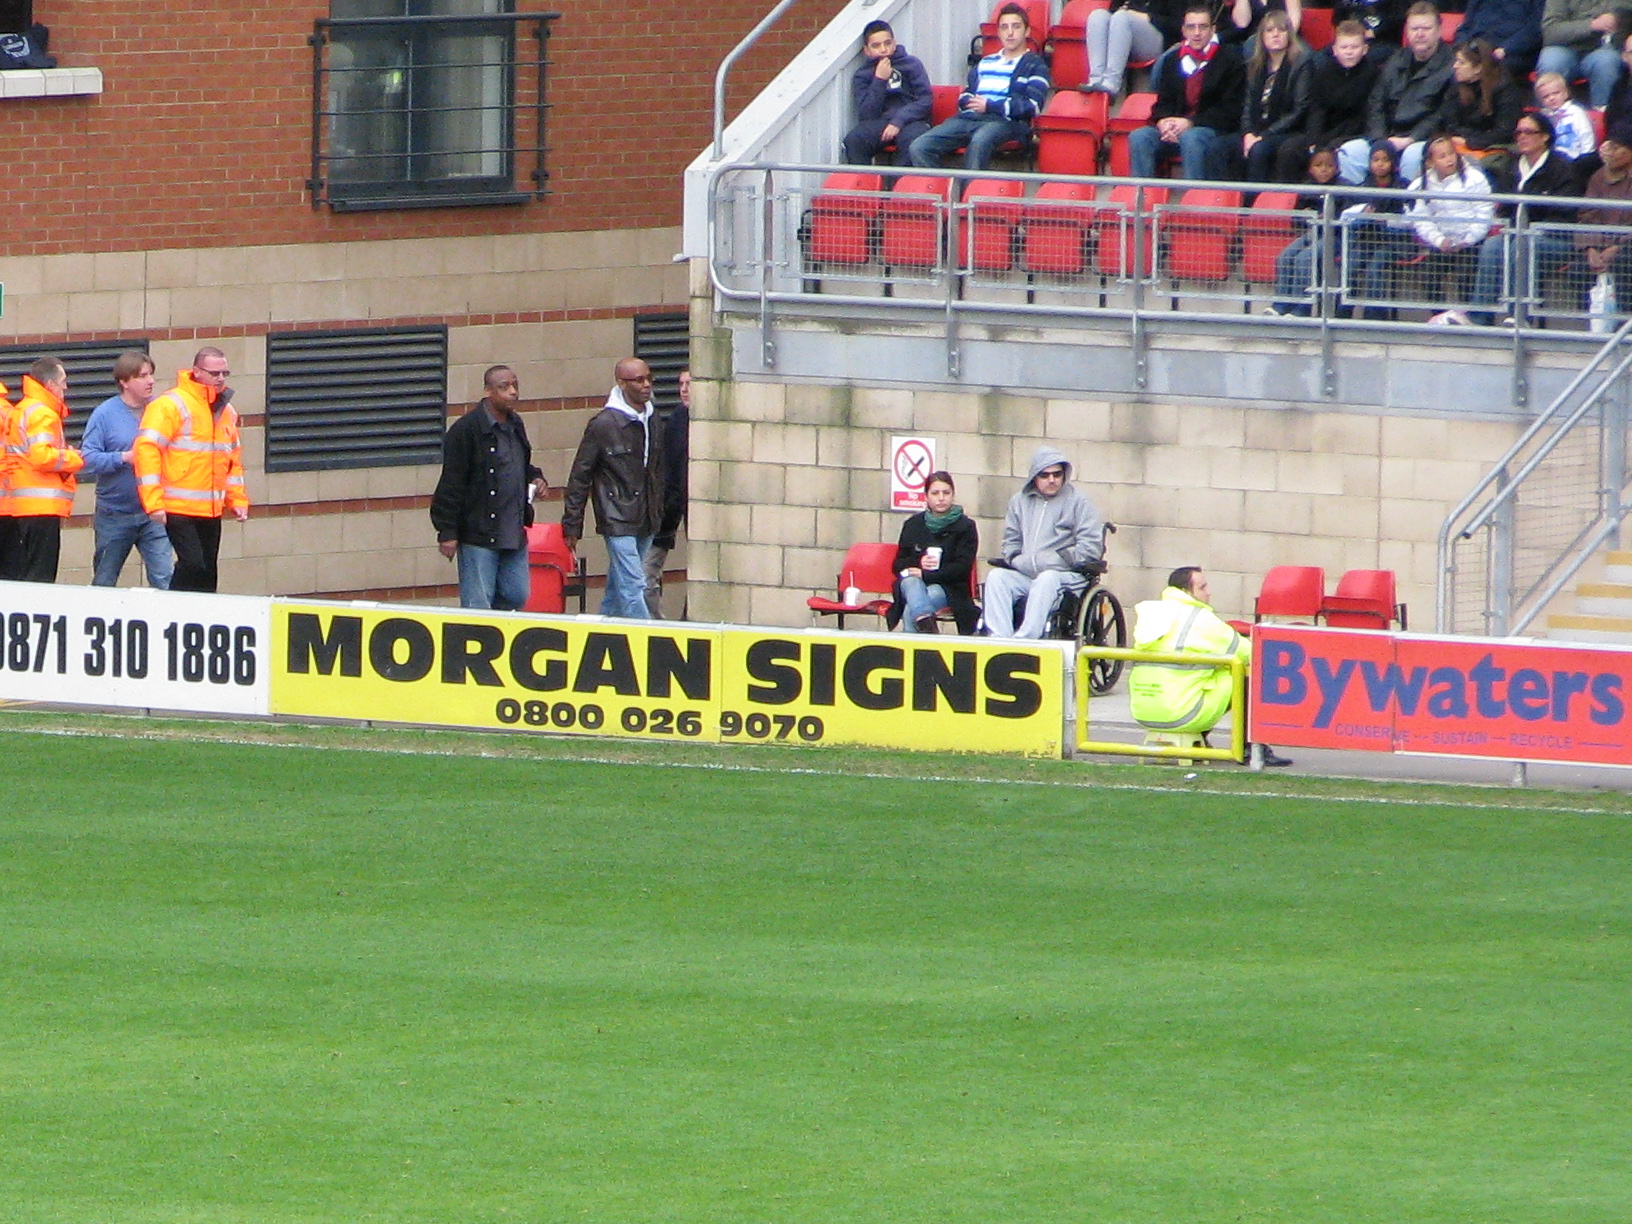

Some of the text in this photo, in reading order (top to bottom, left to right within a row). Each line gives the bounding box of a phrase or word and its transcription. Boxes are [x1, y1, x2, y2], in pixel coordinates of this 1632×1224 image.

[84, 617, 149, 679] 310
[163, 622, 257, 686] 1886
[286, 612, 1042, 719] MORGAN SIGNS
[1260, 639, 1625, 729] Bywaters
[496, 698, 825, 742] 0800 026 9070
[1334, 723, 1410, 743] CONSERVE
[1509, 733, 1572, 748] RECYCLE
